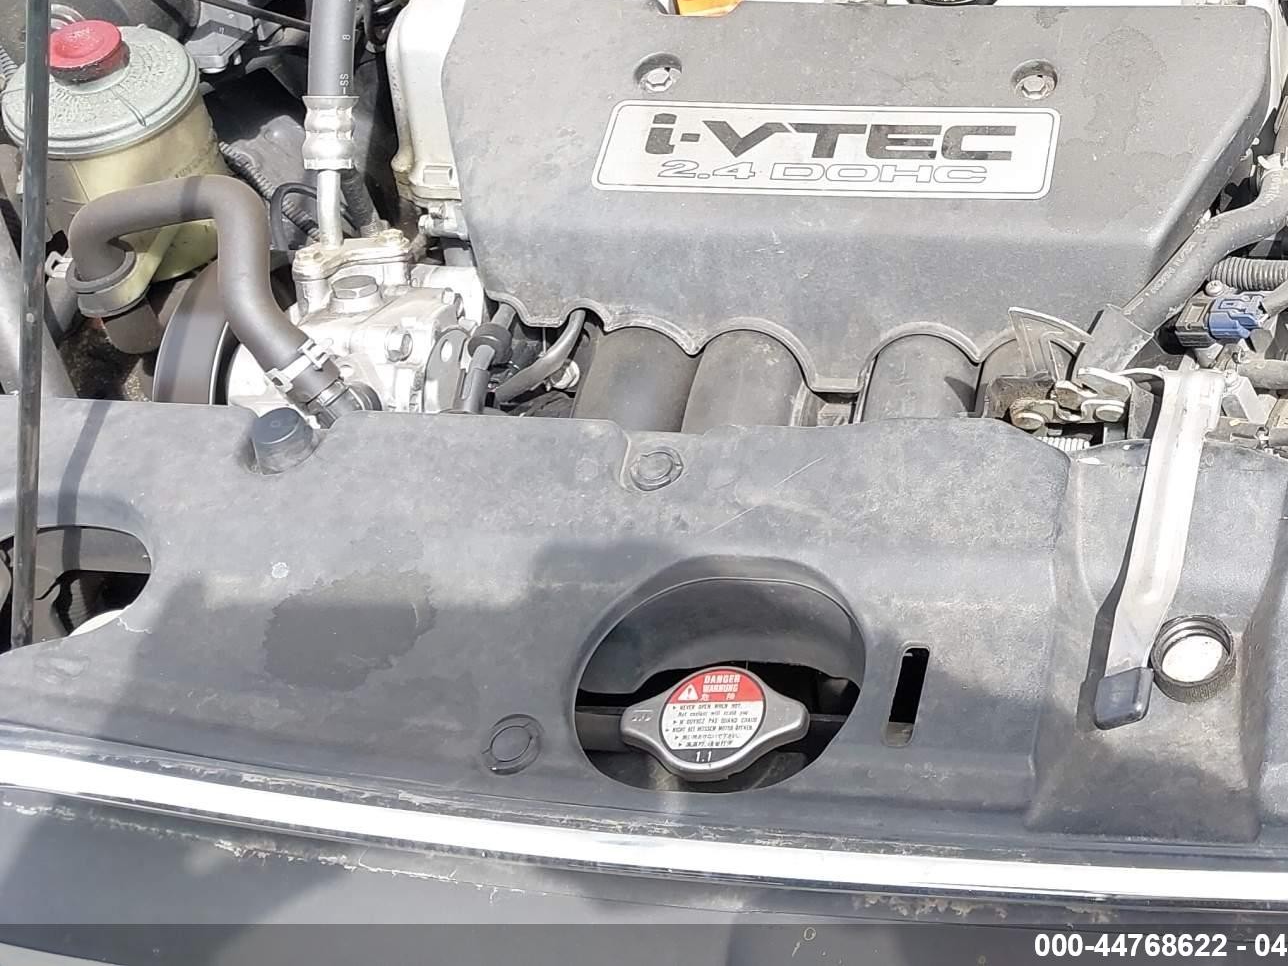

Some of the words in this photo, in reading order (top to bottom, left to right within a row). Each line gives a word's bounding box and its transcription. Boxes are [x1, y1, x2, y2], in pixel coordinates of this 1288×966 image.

[645, 113, 1017, 161] i-VTEC
[658, 159, 756, 181] 2.4
[770, 162, 987, 184] DOHC
[703, 674, 741, 684] DANGER
[695, 750, 713, 763] 1.1
